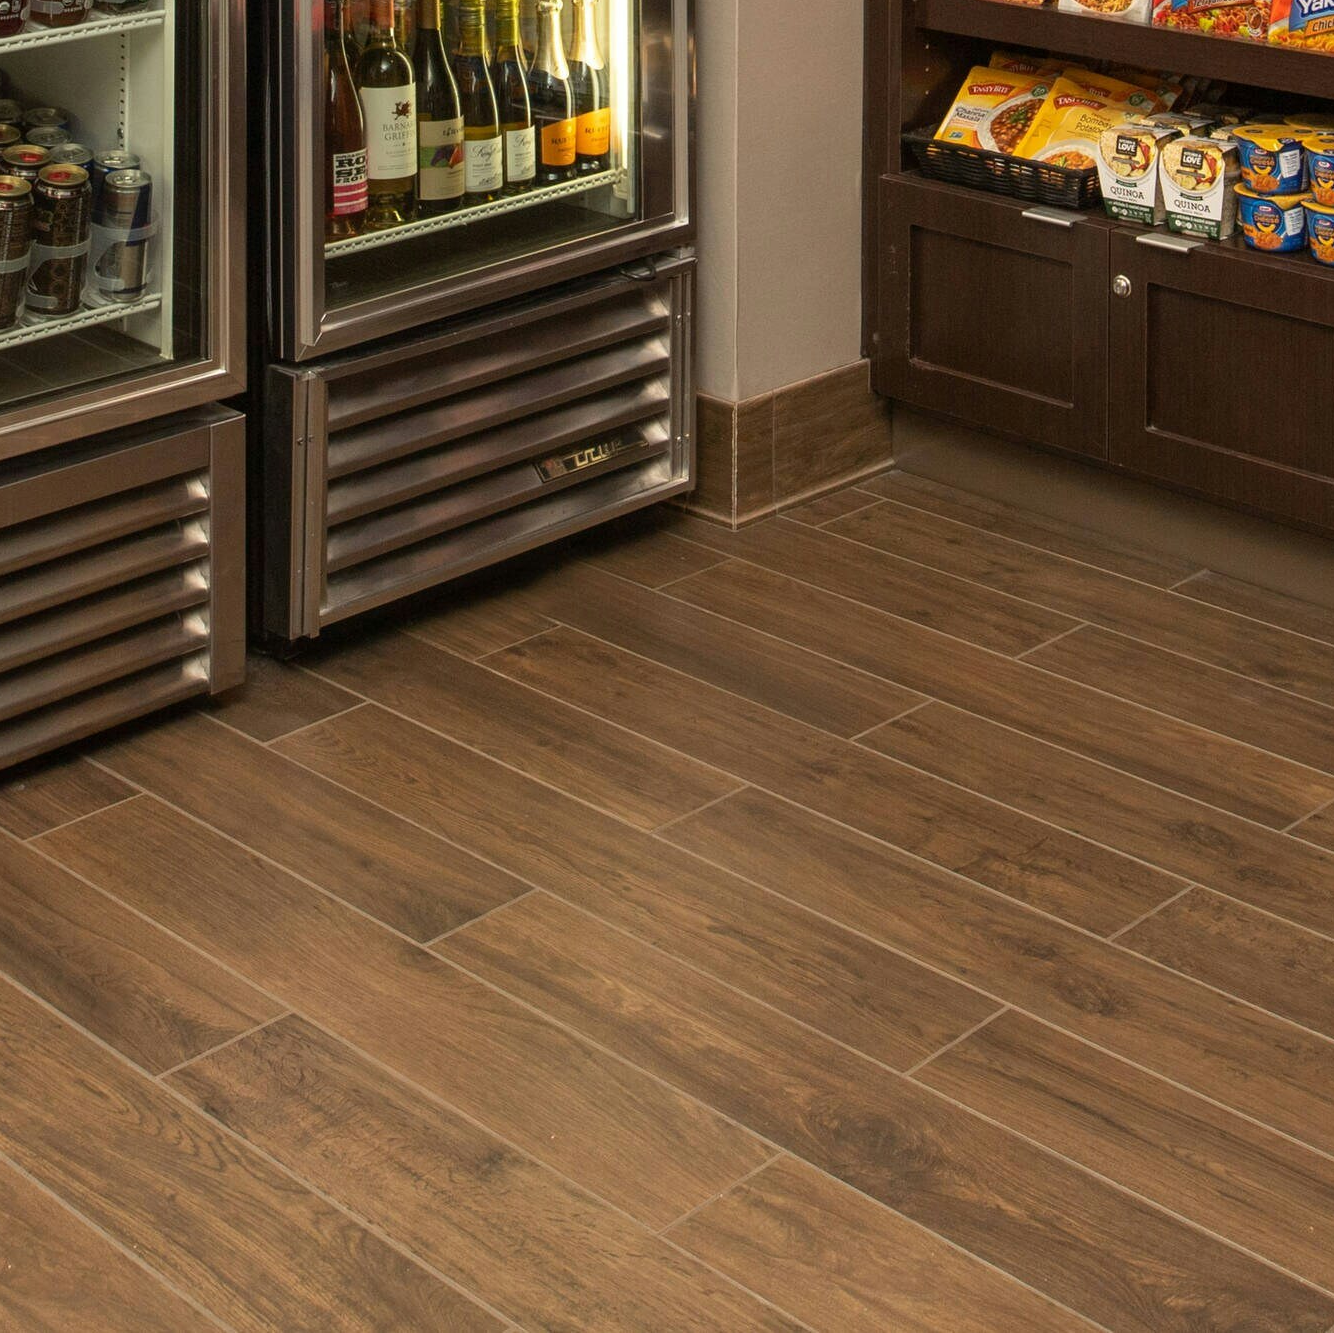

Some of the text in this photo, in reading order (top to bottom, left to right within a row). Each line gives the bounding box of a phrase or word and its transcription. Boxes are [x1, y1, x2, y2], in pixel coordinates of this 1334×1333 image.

[1117, 142, 1138, 154] LOVE
[1183, 155, 1203, 166] LOVE
[1110, 185, 1145, 201] QUINOA
[1173, 199, 1212, 214] QUINOA
